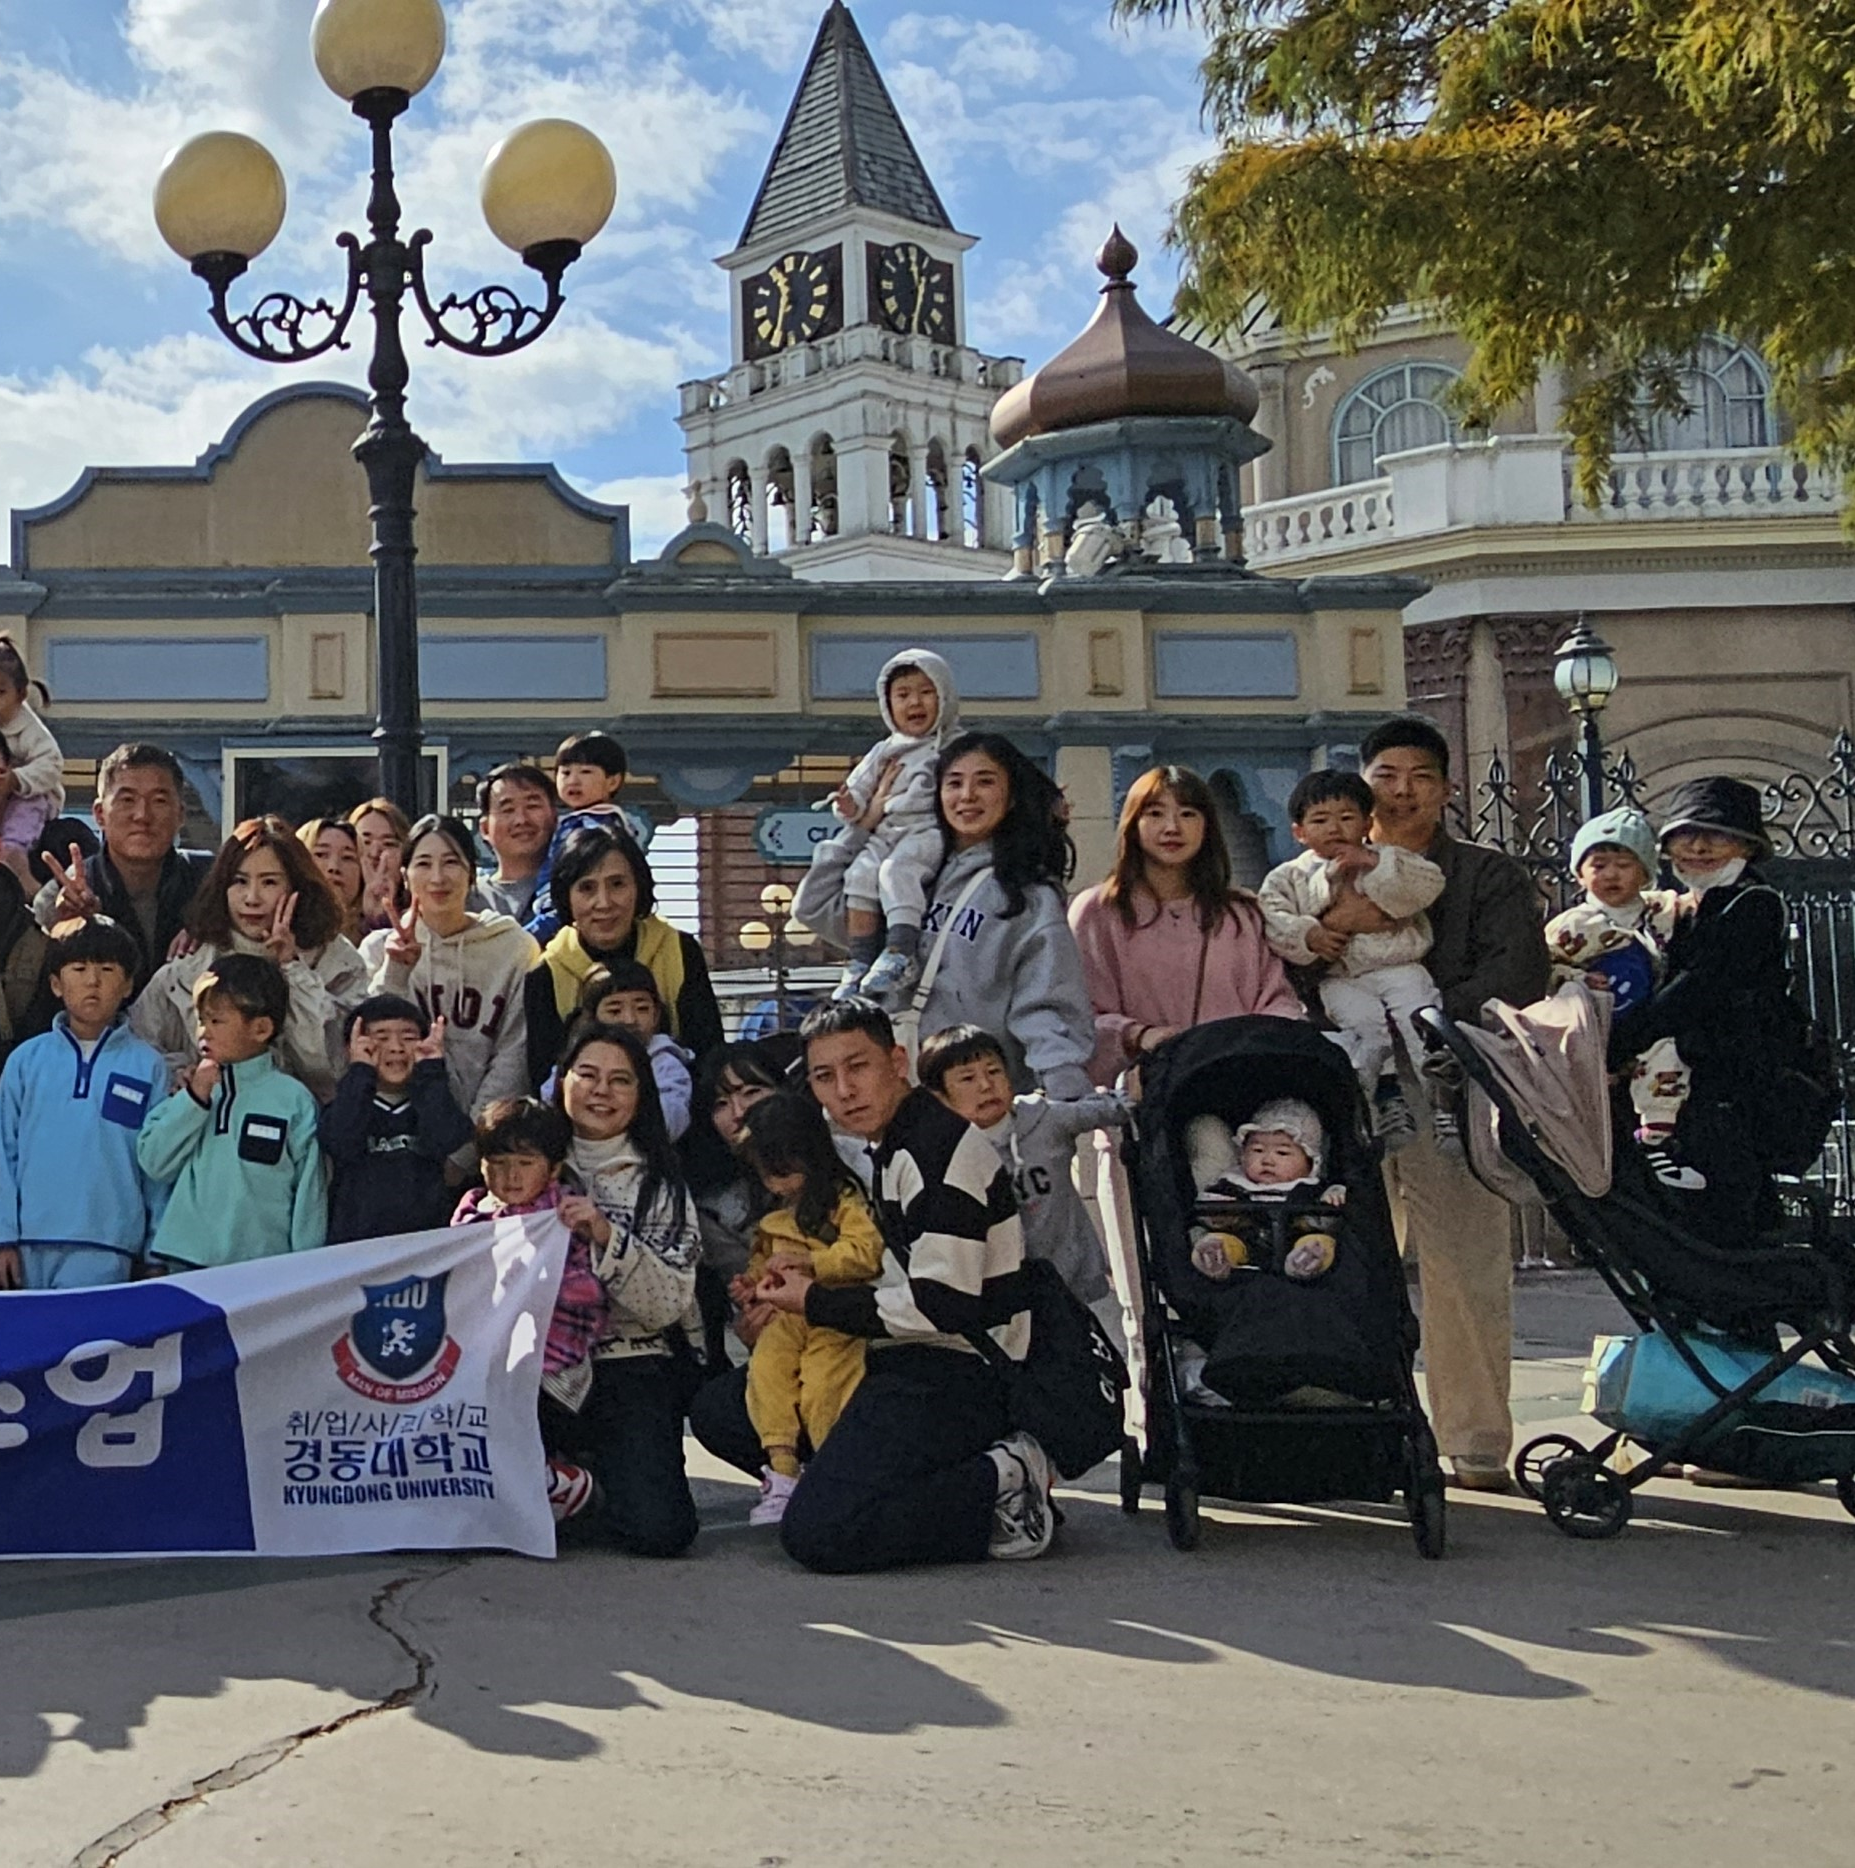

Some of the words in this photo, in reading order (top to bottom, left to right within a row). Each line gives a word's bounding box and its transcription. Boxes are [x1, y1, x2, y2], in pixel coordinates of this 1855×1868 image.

[346, 1371, 374, 1396] MAN
[375, 1387, 395, 1400] OF
[396, 1372, 447, 1401] MISSION
[283, 1432, 493, 1482] 경동대학교
[283, 1482, 394, 1506] KYUNGDONG
[395, 1477, 495, 1501] UNIVERSITY
